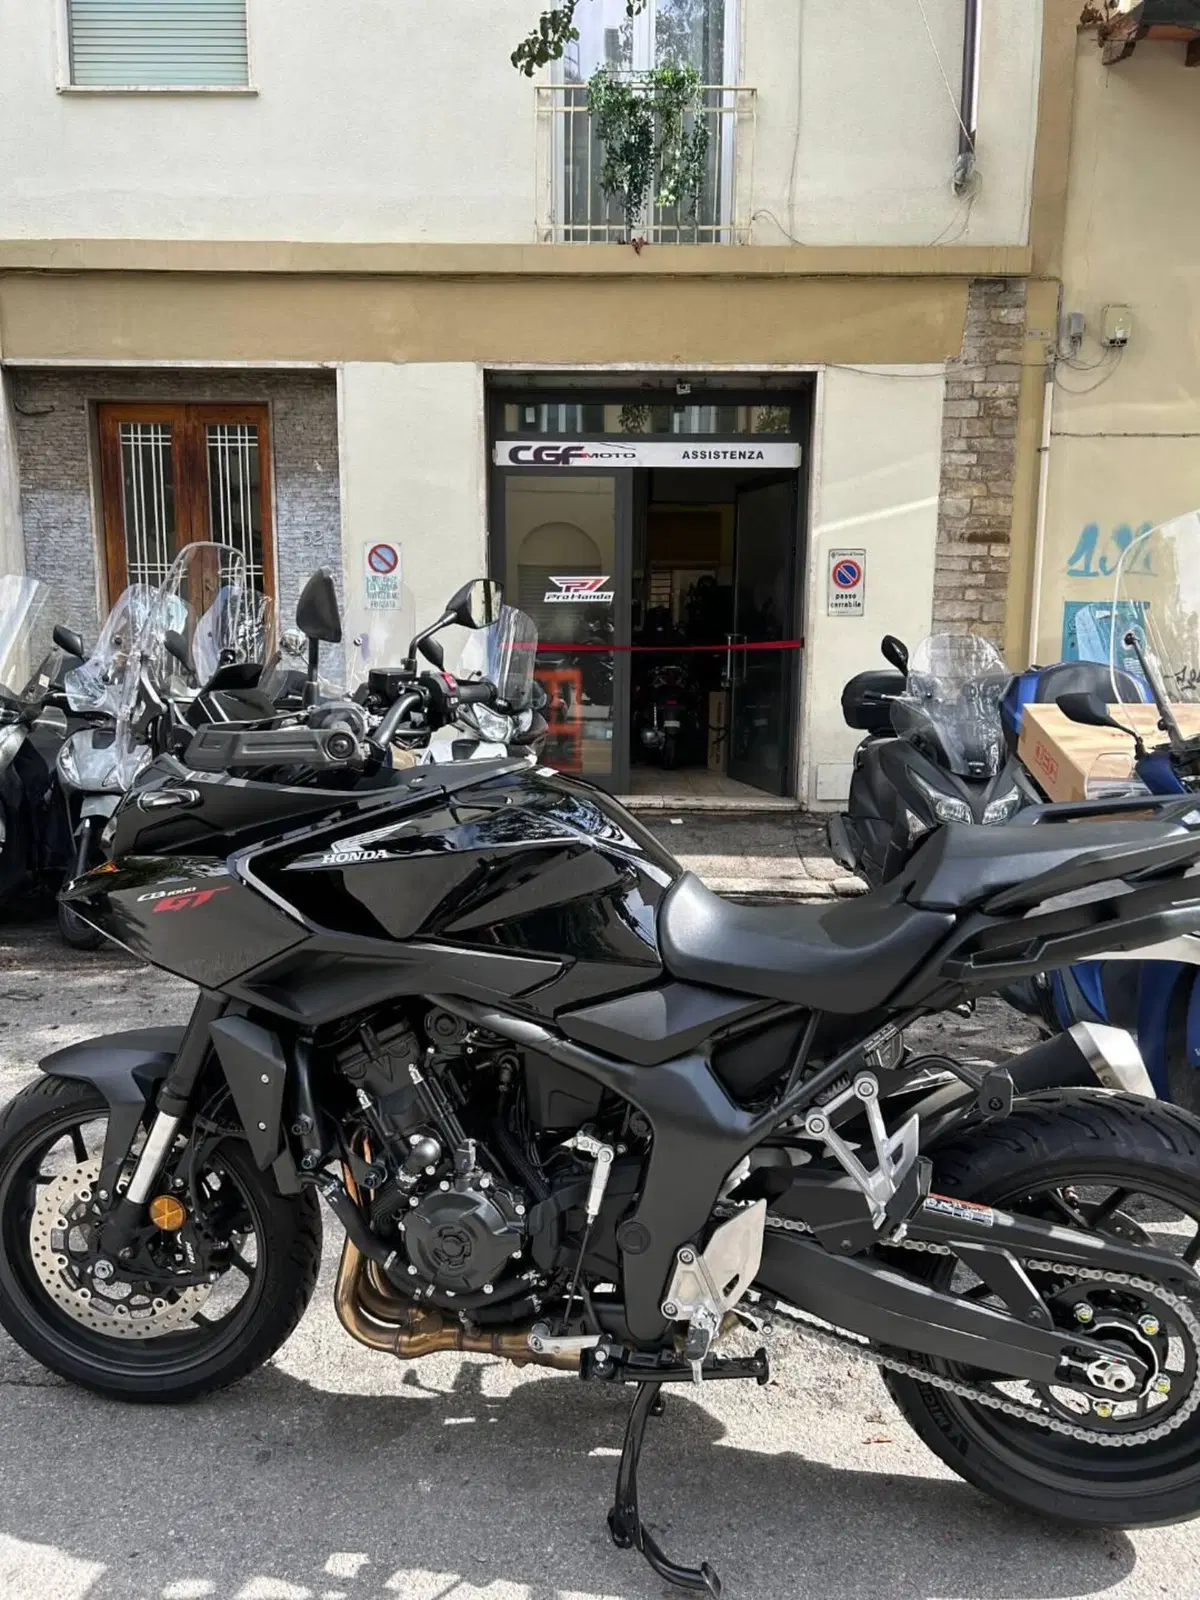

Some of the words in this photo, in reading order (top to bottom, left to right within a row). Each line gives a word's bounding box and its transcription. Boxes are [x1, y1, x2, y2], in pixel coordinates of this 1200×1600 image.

[508, 445, 585, 465] CGF
[681, 450, 764, 460] ASSISTENZA
[321, 849, 389, 864] HONDA
[152, 886, 232, 913] GT
